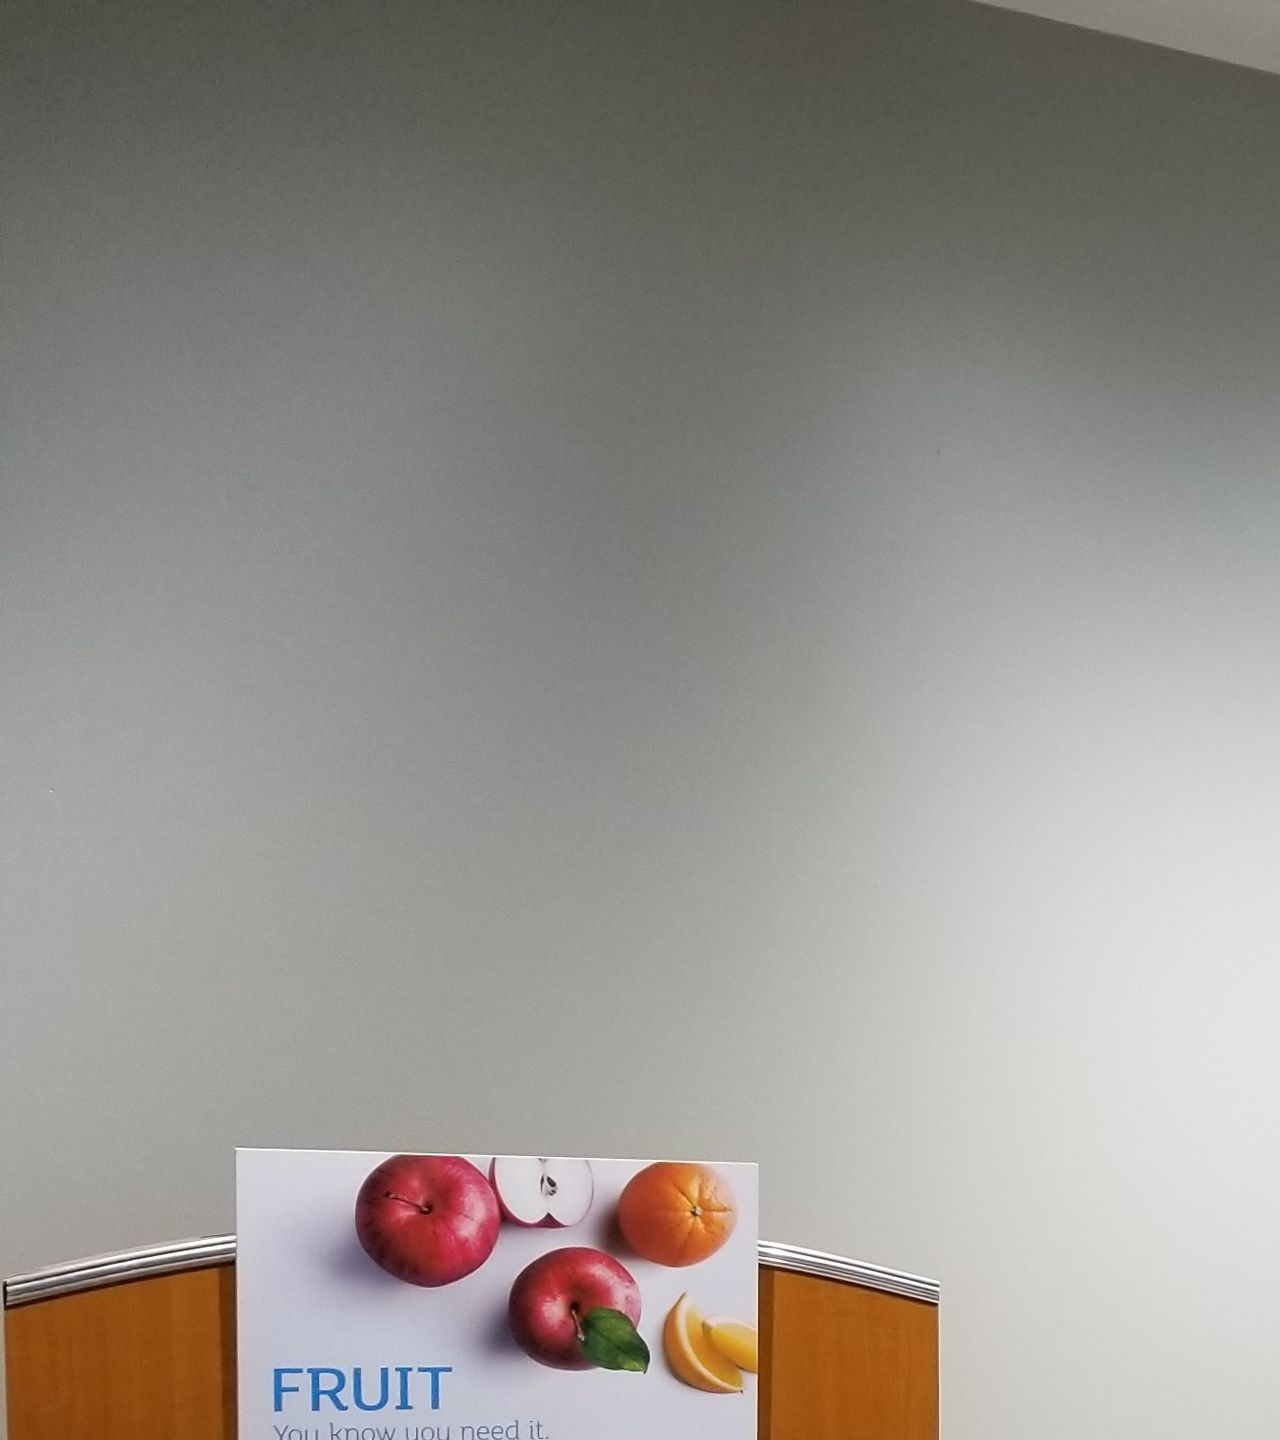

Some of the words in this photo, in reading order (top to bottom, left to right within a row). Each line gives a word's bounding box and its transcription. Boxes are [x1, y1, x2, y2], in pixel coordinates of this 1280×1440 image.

[272, 1366, 453, 1412] FRUIT
[460, 1420, 519, 1440] need
[528, 1420, 550, 1440] it.
